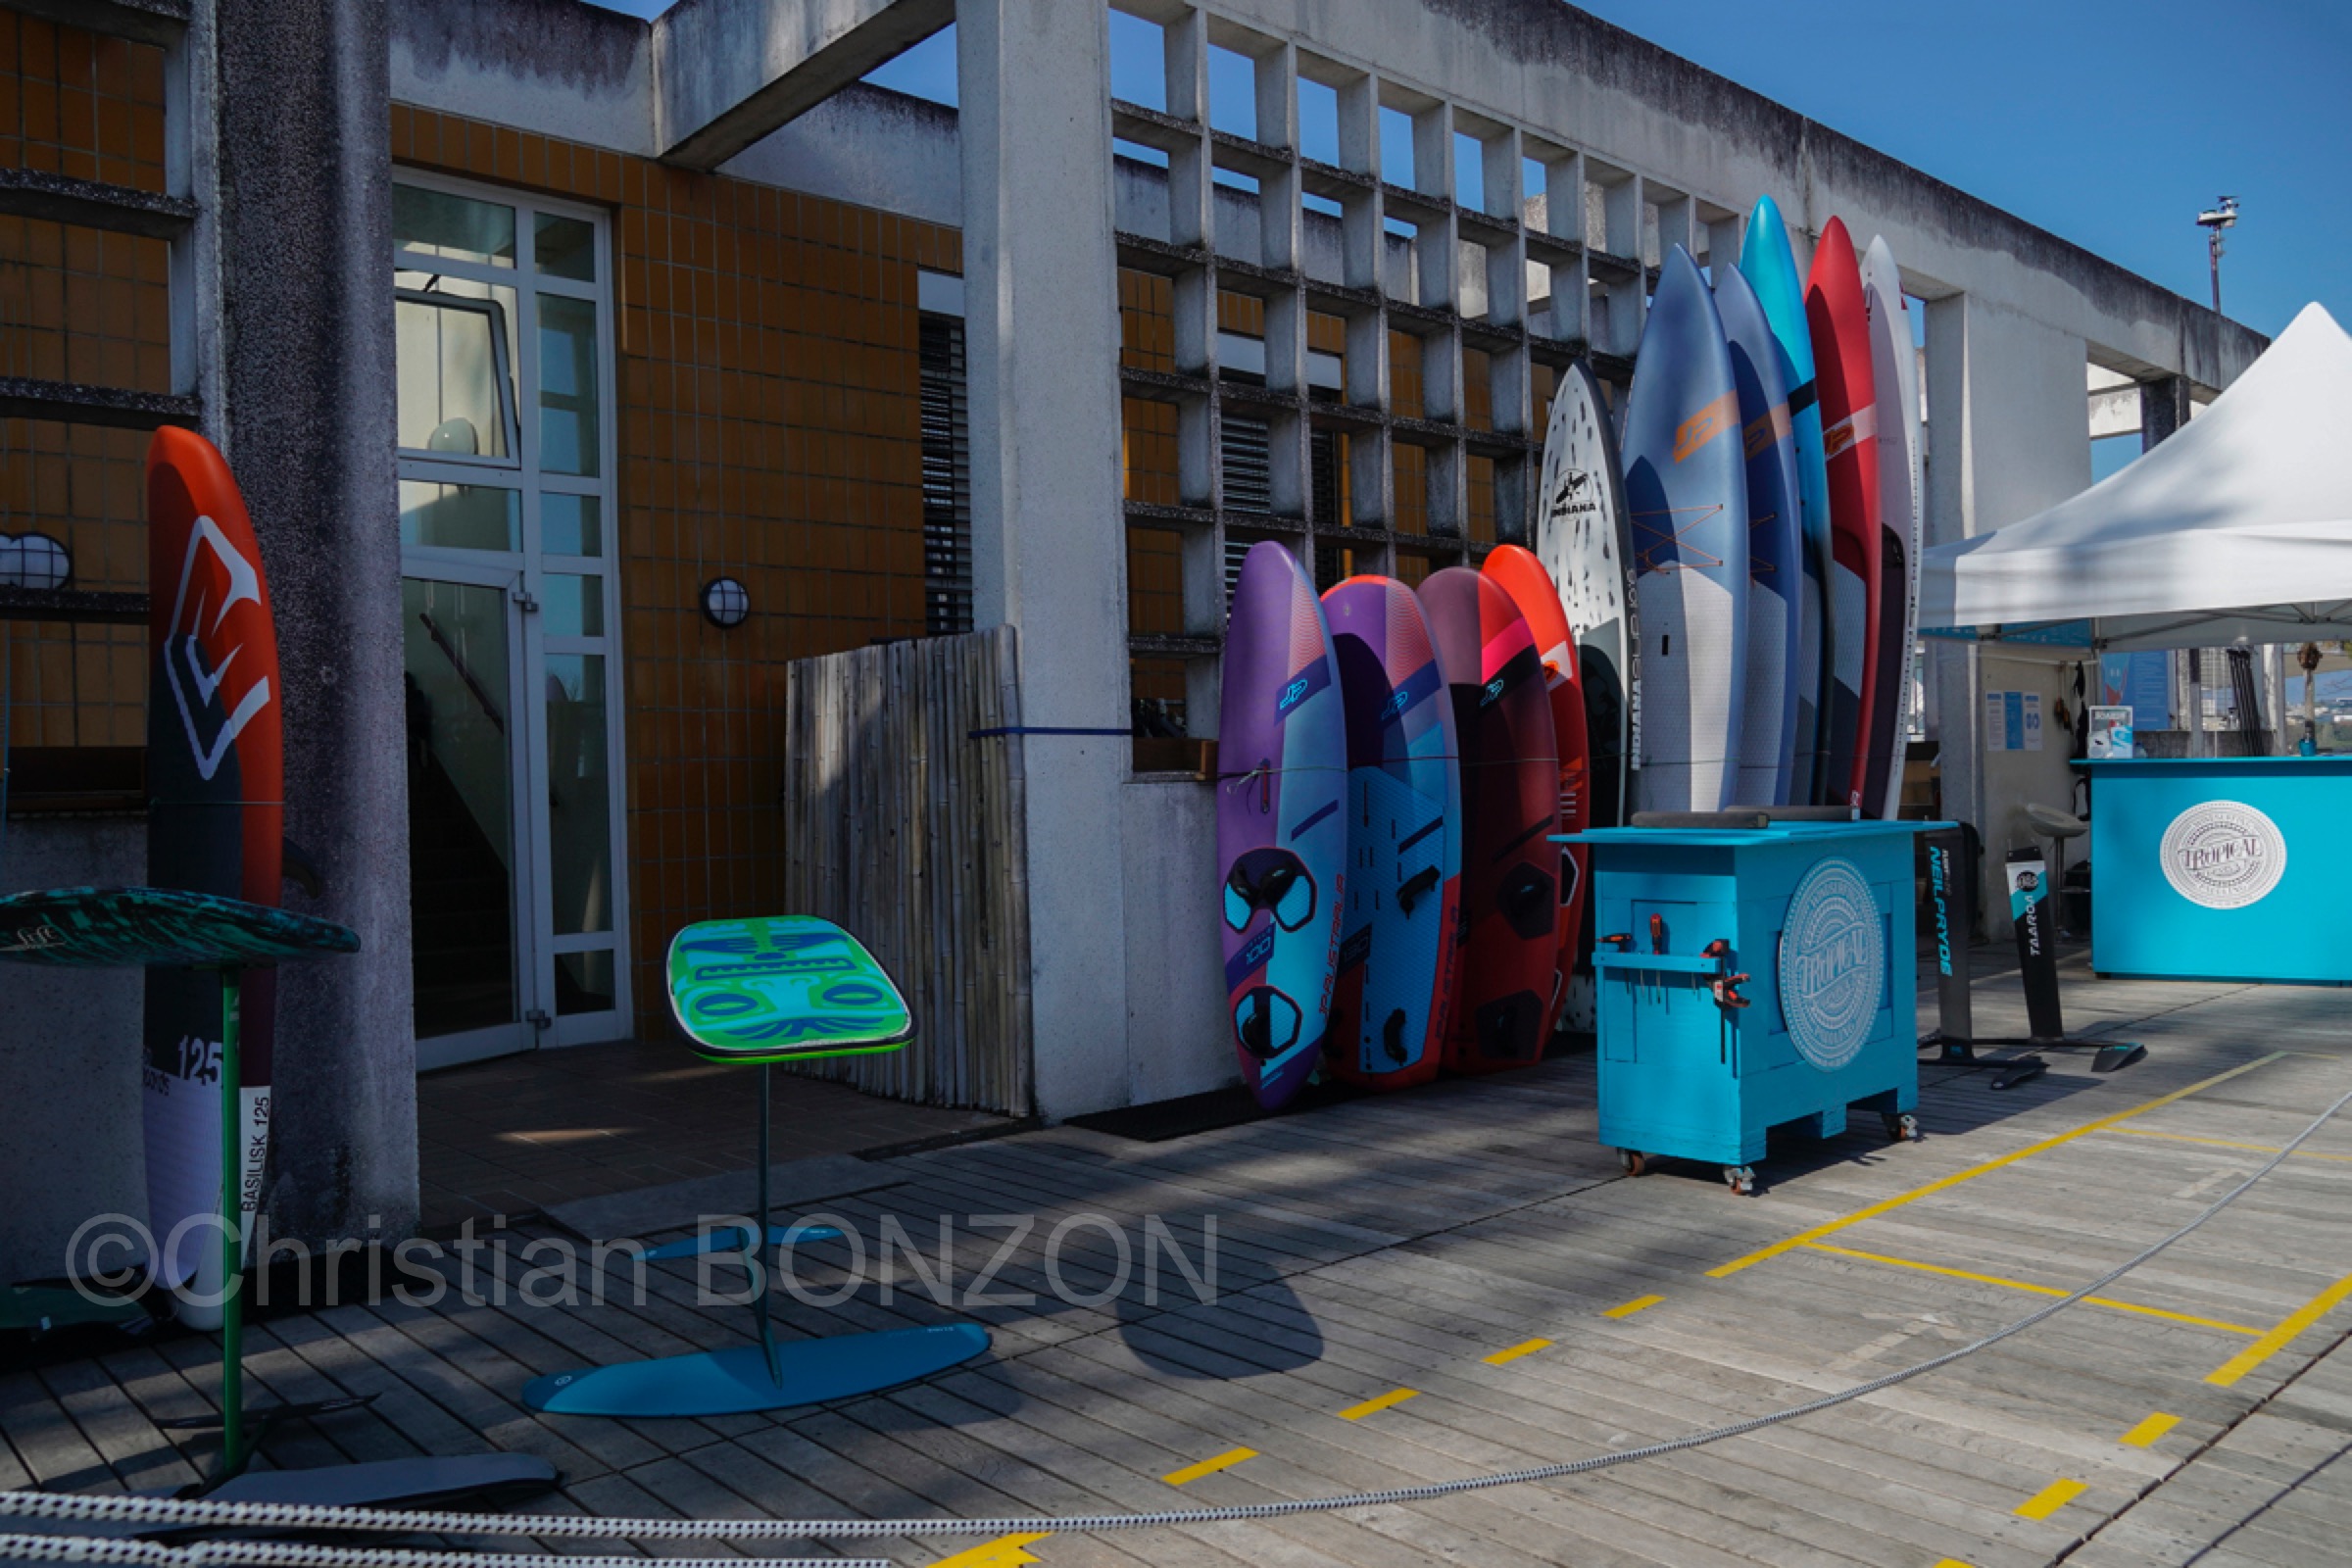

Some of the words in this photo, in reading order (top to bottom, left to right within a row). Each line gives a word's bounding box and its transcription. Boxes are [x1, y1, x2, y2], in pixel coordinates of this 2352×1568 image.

[1630, 679, 1642, 771] INDIANA
[1929, 845, 1953, 978] NEILPRYDE
[2025, 895, 2041, 956] TAAROA
[177, 1034, 224, 1085] 125
[241, 1134, 267, 1212] BASILISK
[254, 1096, 270, 1128] 125
